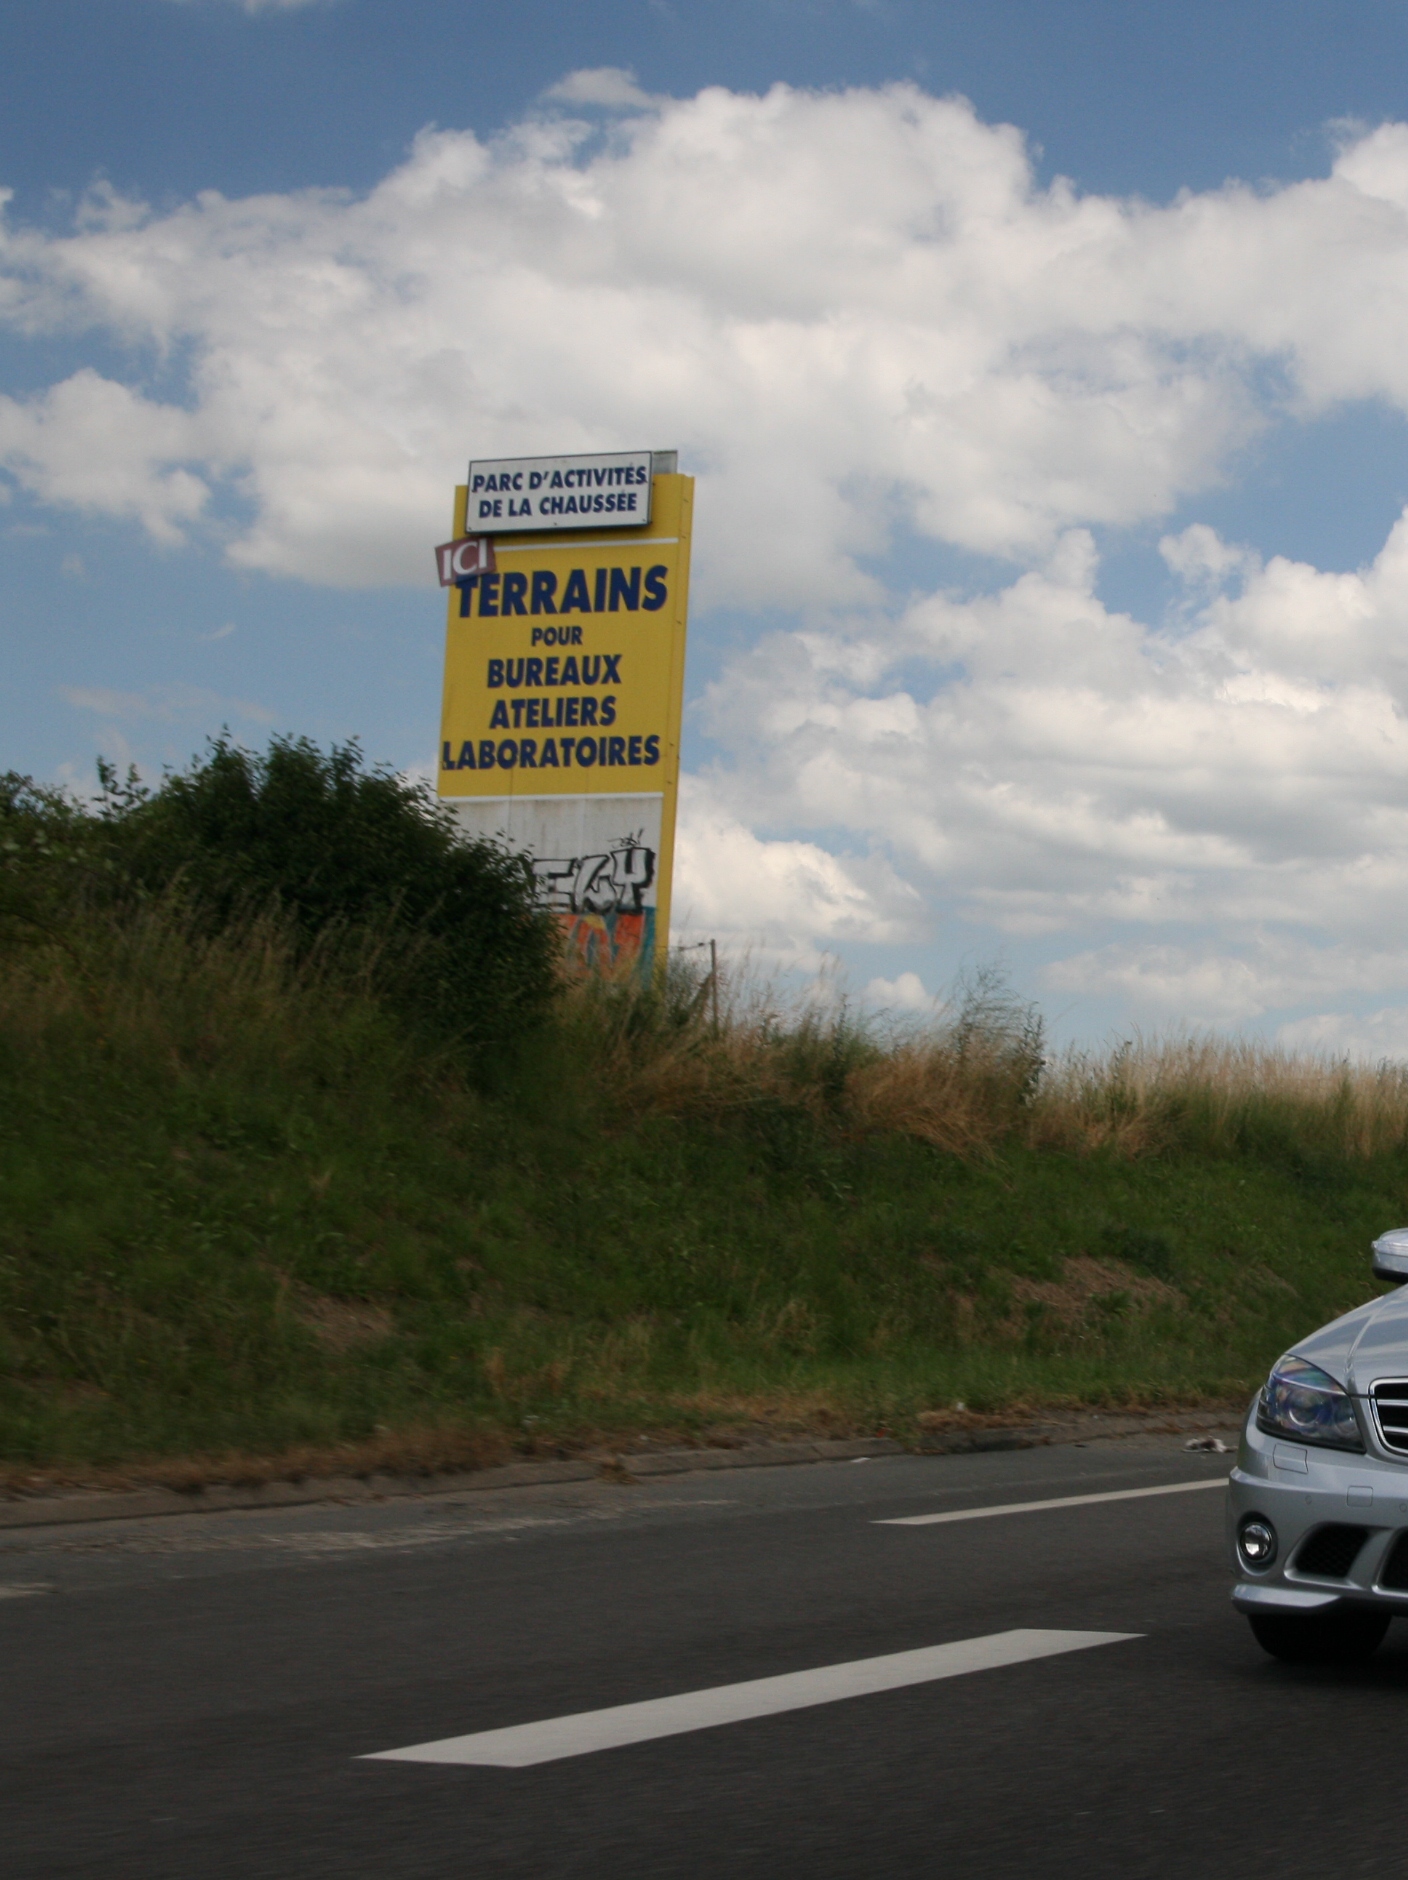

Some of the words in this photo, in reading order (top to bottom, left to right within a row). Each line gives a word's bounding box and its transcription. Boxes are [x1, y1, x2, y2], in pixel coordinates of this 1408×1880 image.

[472, 471, 523, 492] PARC
[529, 463, 647, 490] D'ACTIVITÉS
[479, 500, 502, 518] DE
[508, 498, 532, 516] LA
[539, 490, 637, 515] CHAUSSÉE
[443, 538, 487, 580] ICI
[455, 565, 669, 618] TERRAINS
[531, 626, 583, 647] POUR
[487, 654, 622, 688] BUREAUX
[489, 695, 617, 729] ATELIERS
[441, 735, 660, 770] LABORATOIRES
